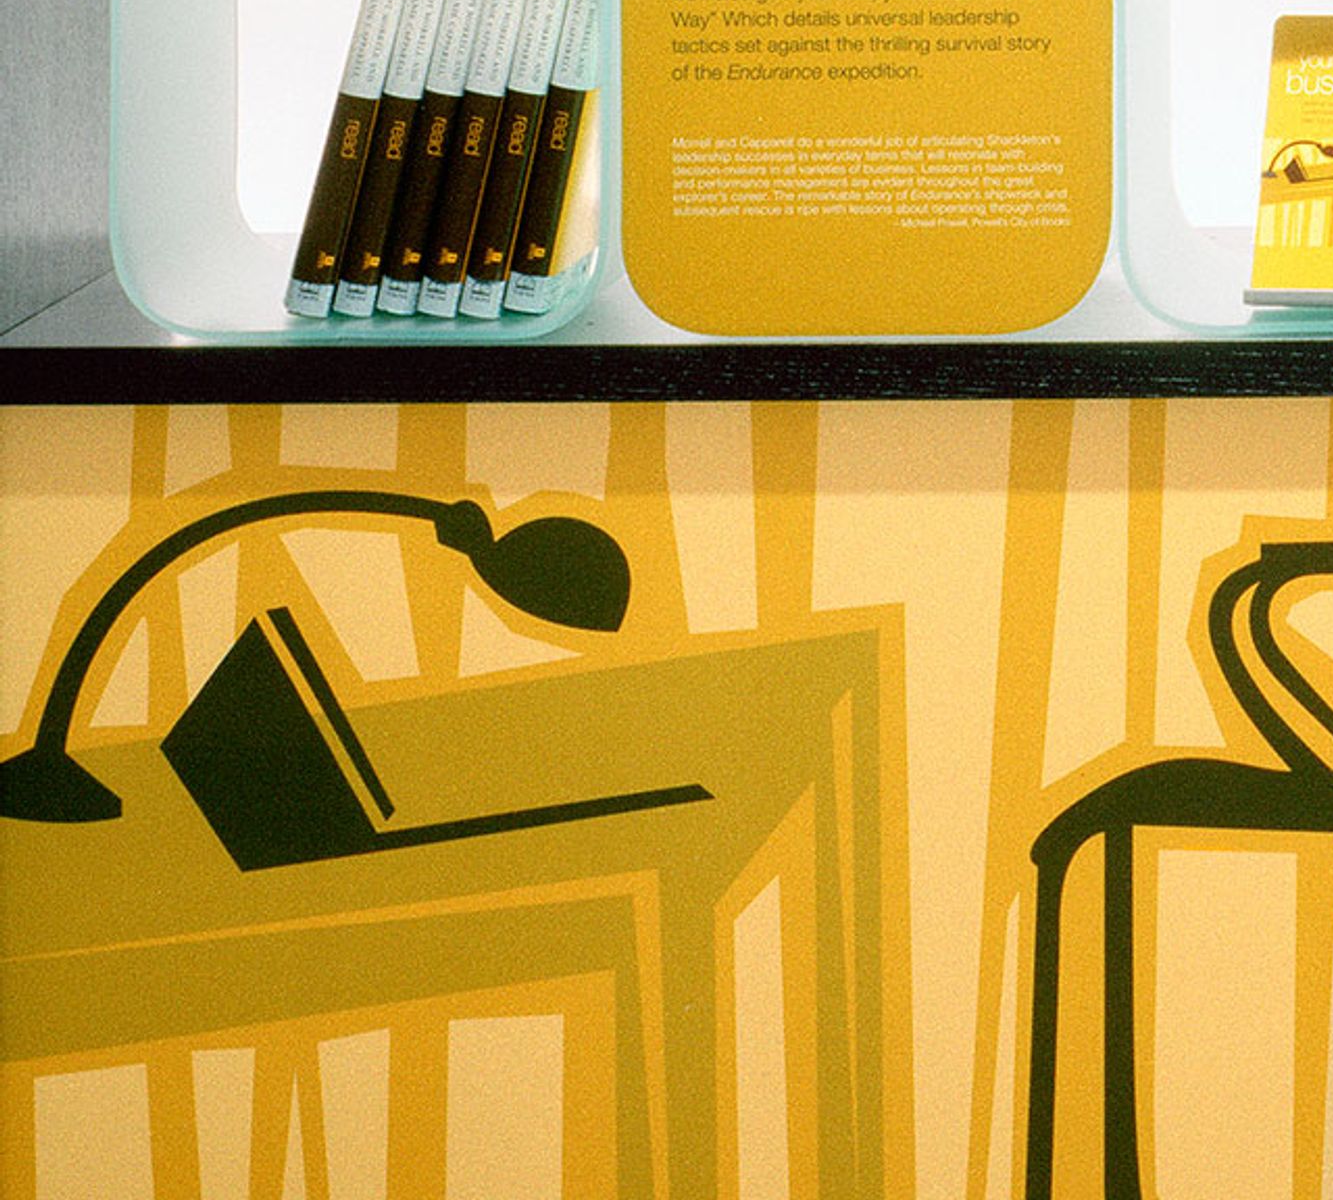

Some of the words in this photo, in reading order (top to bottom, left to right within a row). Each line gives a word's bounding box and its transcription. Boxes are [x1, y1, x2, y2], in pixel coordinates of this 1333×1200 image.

[722, 11, 778, 27] Which
[784, 11, 840, 27] details
[846, 10, 924, 26] universal
[929, 9, 1020, 30] leadership
[672, 37, 729, 54] tactics
[735, 37, 762, 53] set
[767, 37, 830, 57] against
[836, 36, 864, 52] the
[870, 36, 930, 56] thrilling
[936, 35, 1002, 51] survival
[1007, 34, 1051, 55] story
[672, 65, 689, 80] of
[694, 64, 722, 80] the
[727, 63, 822, 80] Endurance
[828, 62, 923, 83] expedition.
[341, 118, 360, 159] read
[386, 119, 406, 160] read
[427, 115, 447, 157] read
[464, 115, 485, 157] read
[508, 114, 529, 156] read
[550, 110, 570, 151] read
